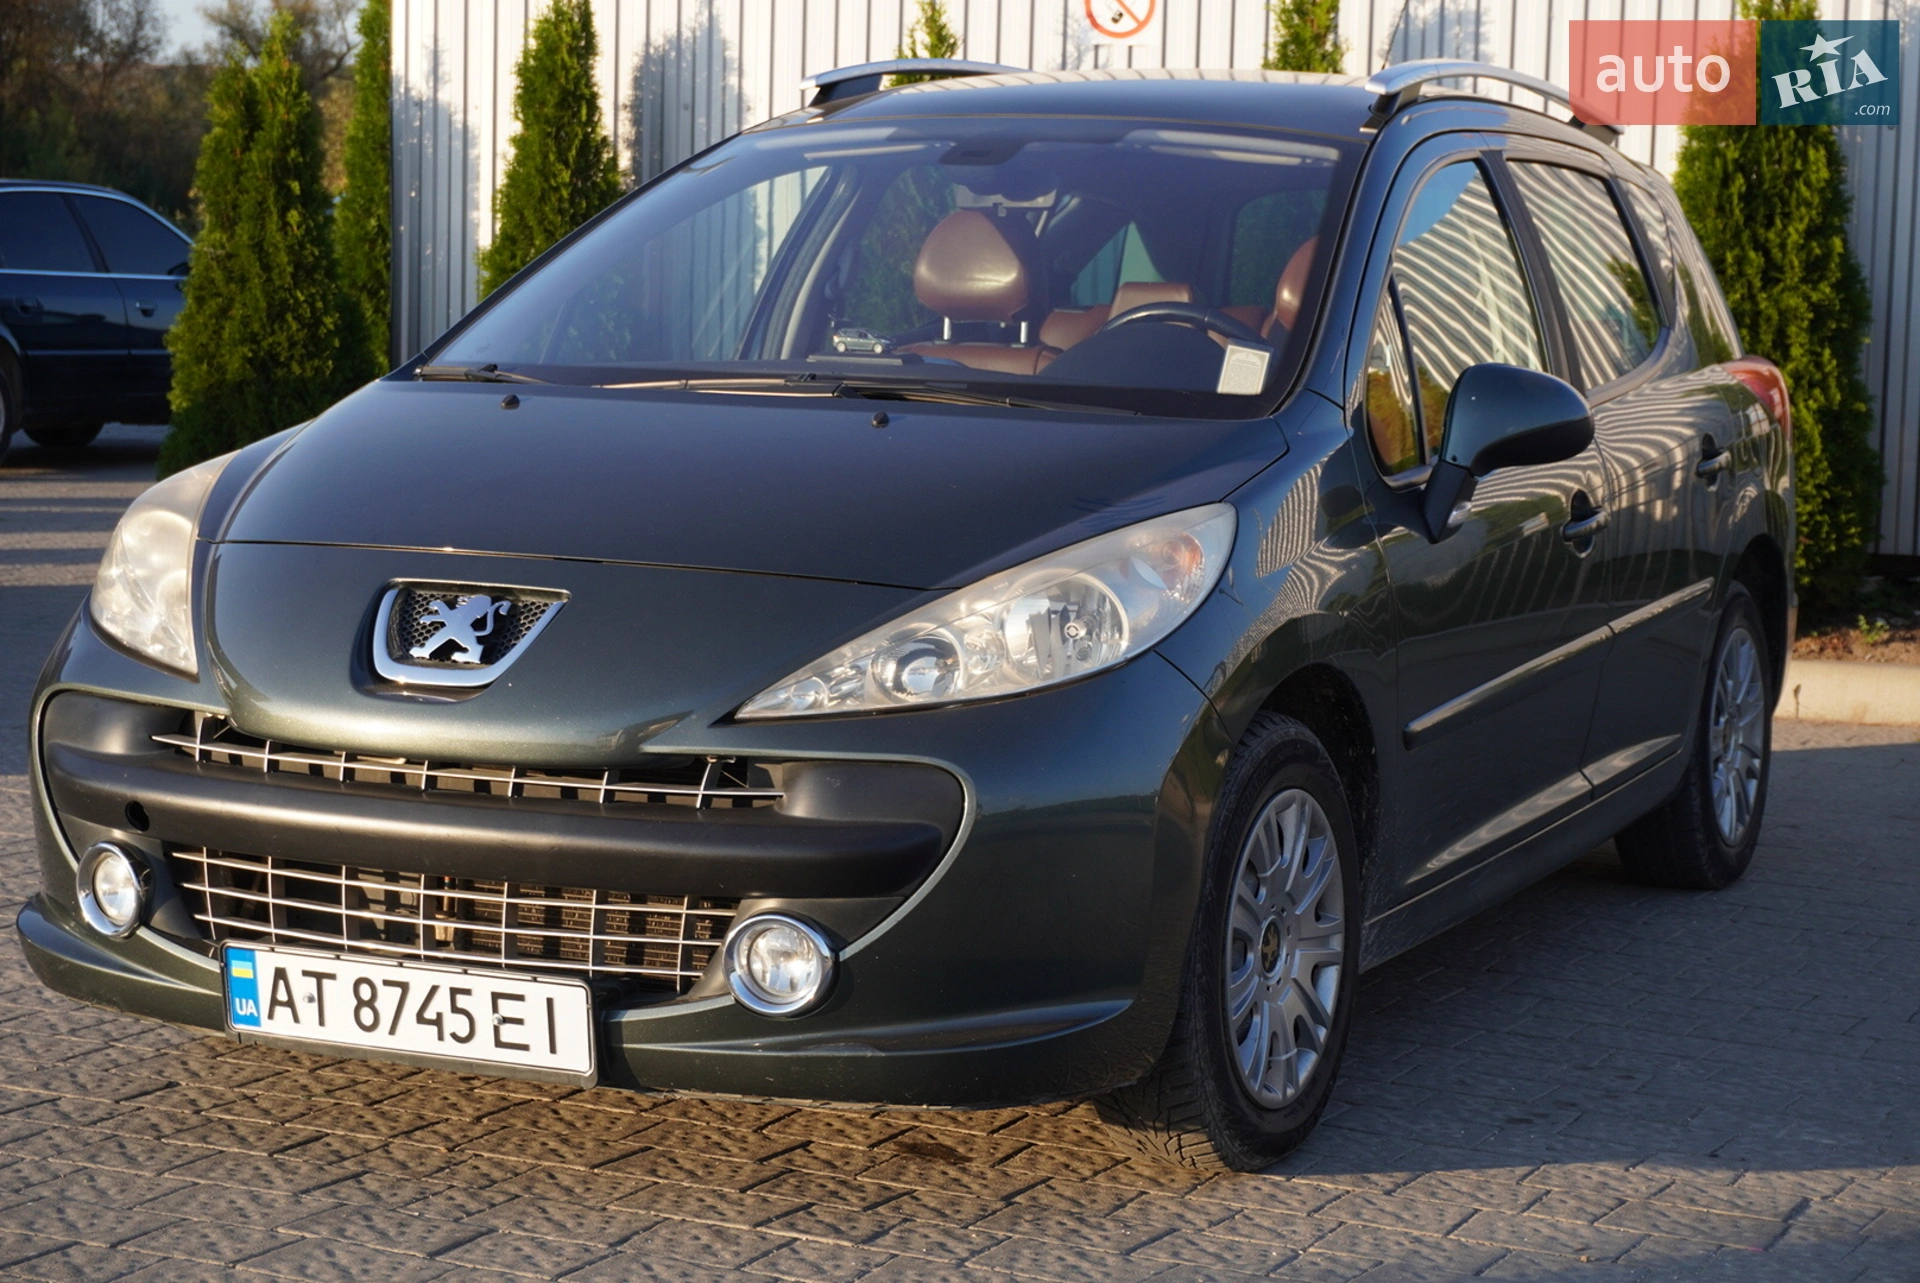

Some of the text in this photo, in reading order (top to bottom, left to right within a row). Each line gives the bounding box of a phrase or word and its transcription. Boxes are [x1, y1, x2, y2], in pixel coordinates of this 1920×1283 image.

[235, 997, 258, 1017] UA
[267, 966, 557, 1055] AT 8745 EI
